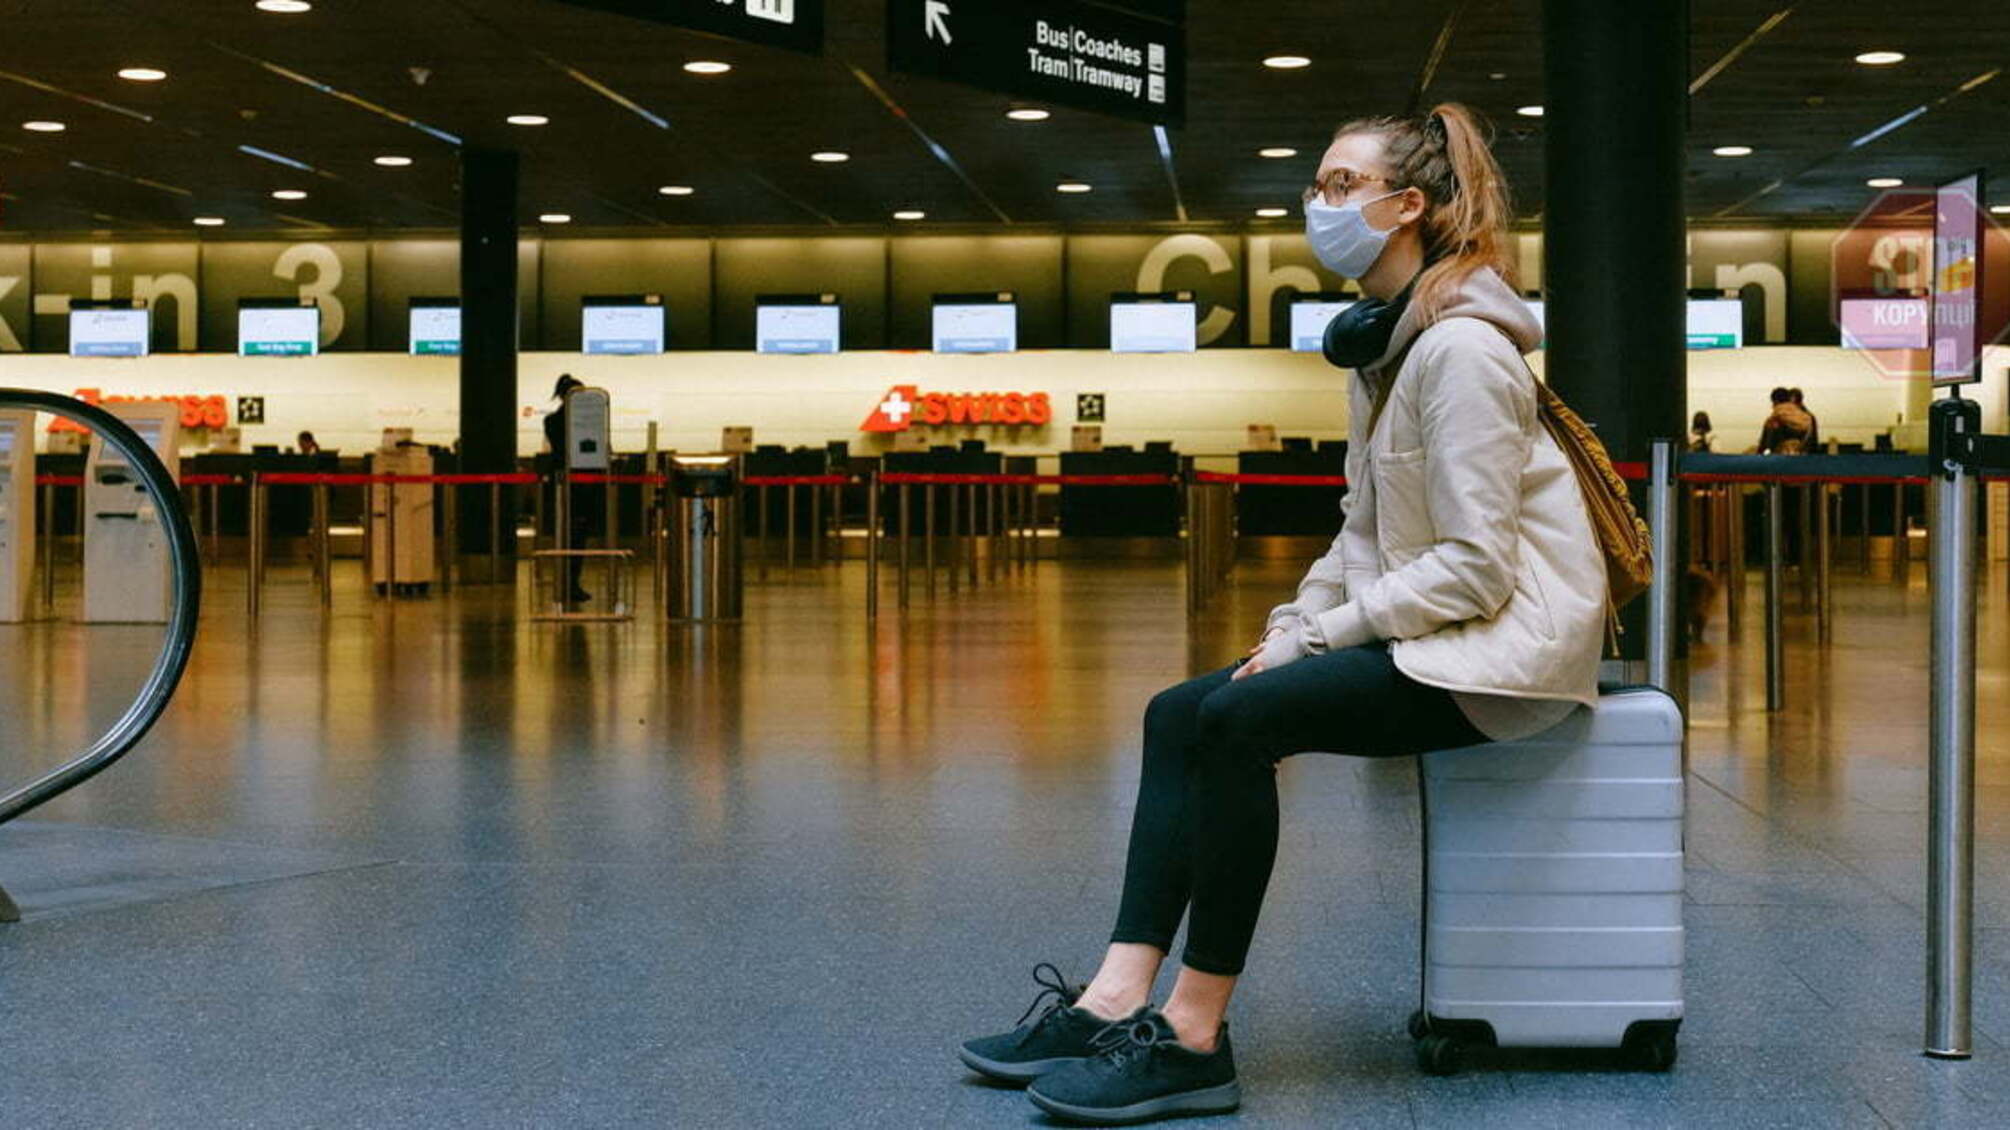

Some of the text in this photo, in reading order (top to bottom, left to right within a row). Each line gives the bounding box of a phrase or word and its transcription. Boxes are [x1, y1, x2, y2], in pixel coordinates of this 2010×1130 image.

[1036, 20, 1142, 66] Bus Coaches
[1028, 48, 1142, 98] Tram Tramway
